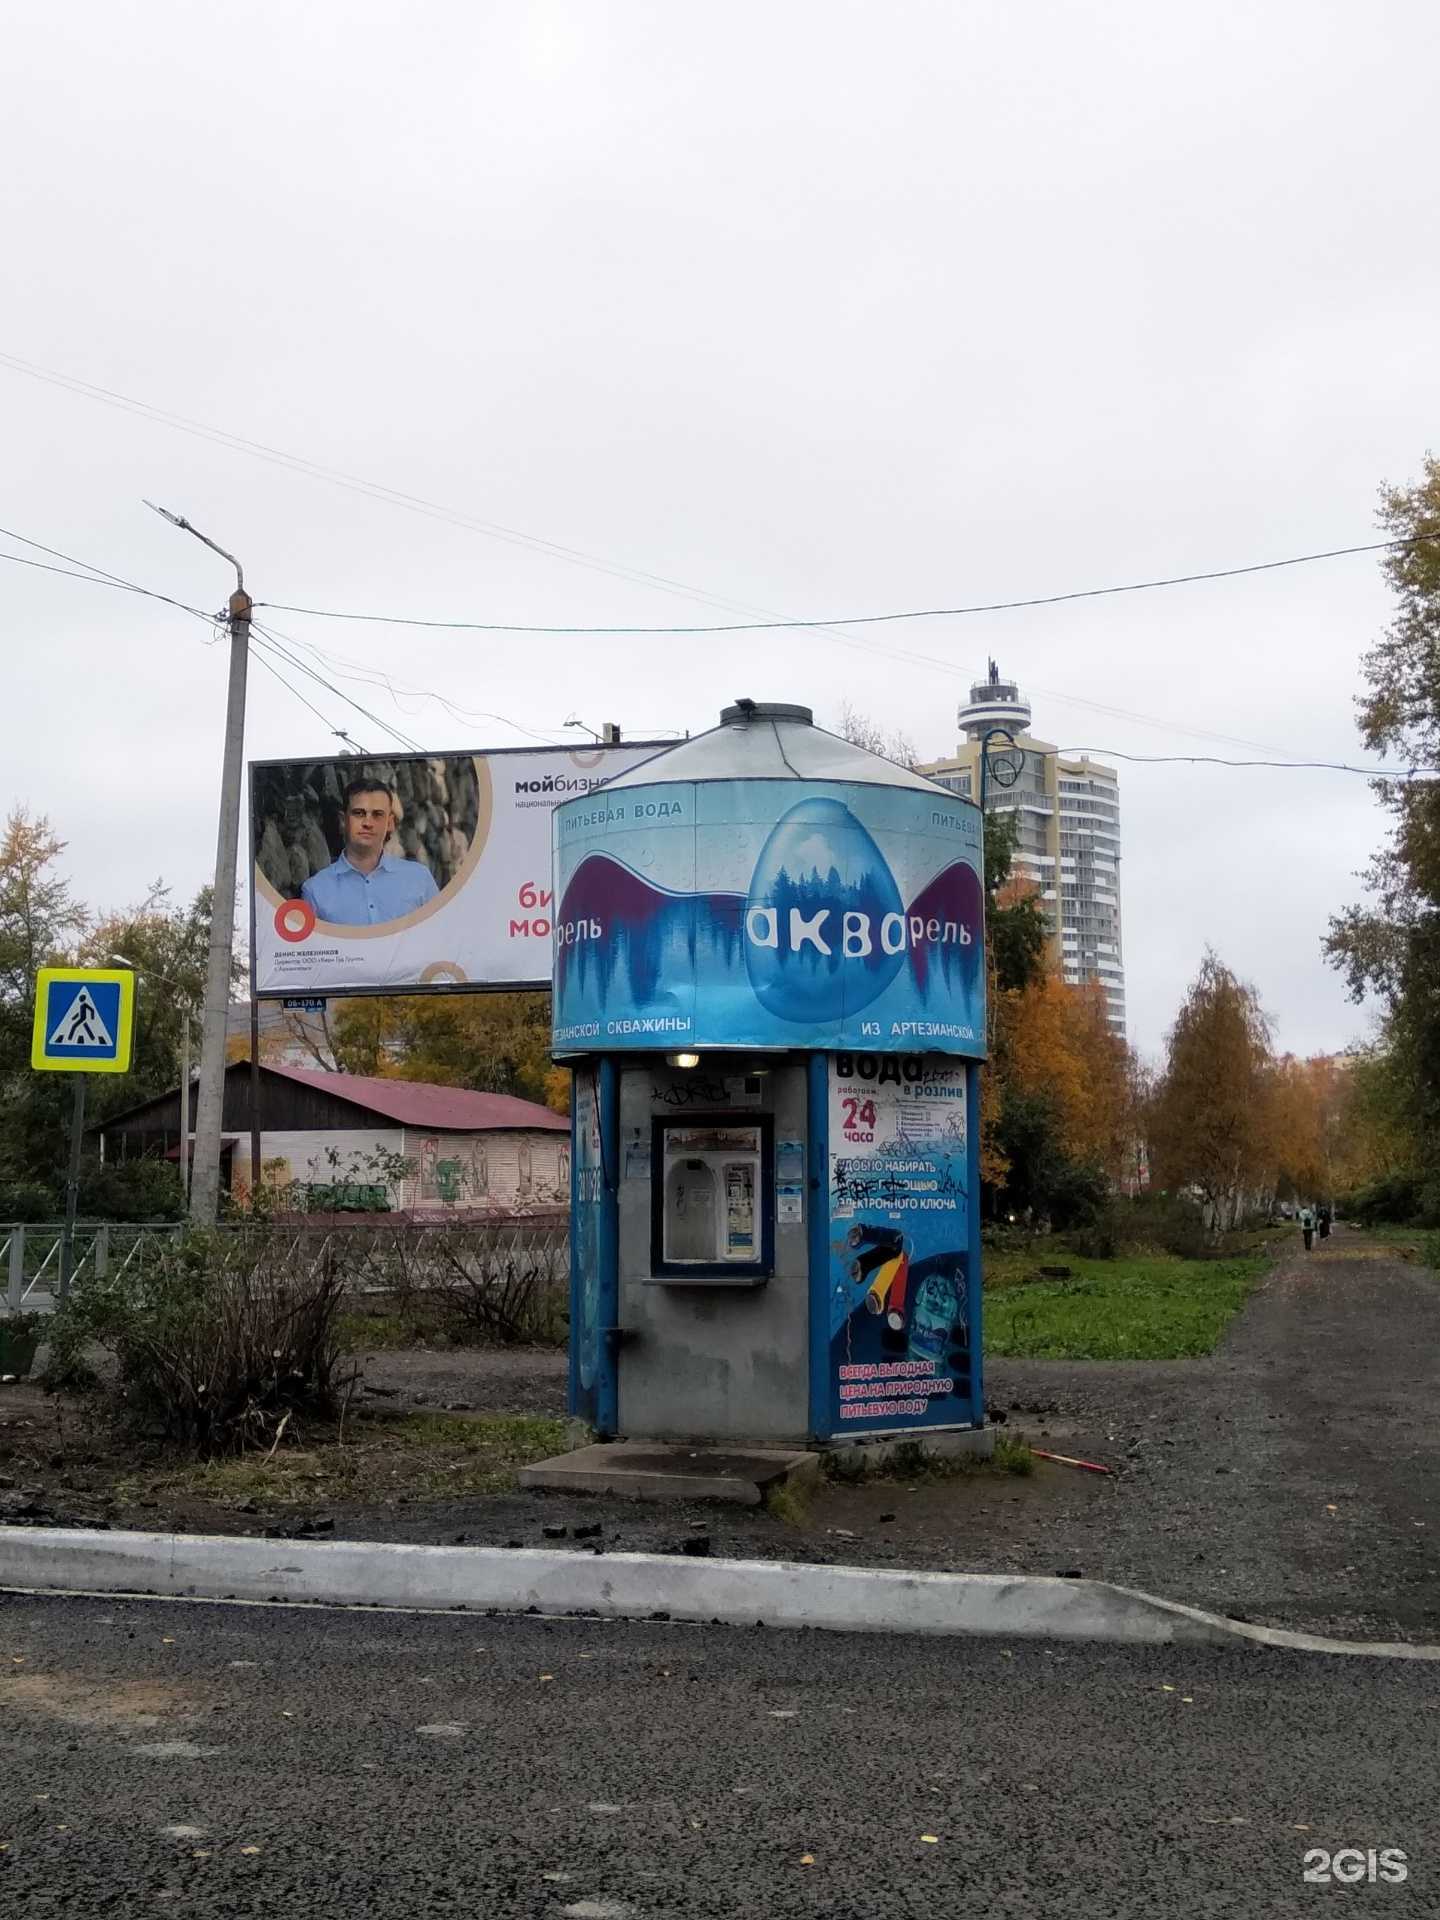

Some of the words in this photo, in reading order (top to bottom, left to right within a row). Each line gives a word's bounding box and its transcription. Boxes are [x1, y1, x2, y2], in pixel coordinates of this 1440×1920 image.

[565, 808, 625, 832] ПИТЬЕВАЯ
[634, 800, 682, 818] ВОДА
[607, 1017, 691, 1035] СКВАЖИНЫ
[861, 1022, 880, 1036] ИЗ
[891, 1022, 975, 1040] АРТЕЗИАНСКОЙ
[915, 1085, 963, 1099] розлив
[842, 1097, 876, 1130] 24
[844, 1131, 874, 1143] часа
[885, 1160, 936, 1172] НАБИРАТЬ
[920, 1198, 957, 1209] КЛЮЧА
[839, 1364, 877, 1380] ВСЕГДА
[879, 1360, 936, 1377] ВЫГОДНАЯ
[840, 1384, 870, 1400] ЦЕНА
[870, 1382, 886, 1397] НА
[886, 1378, 954, 1395] ПРИРОДНУЮ
[840, 1401, 898, 1418] ПИТЬЕВУЮ
[899, 1399, 928, 1415] ВОДУ
